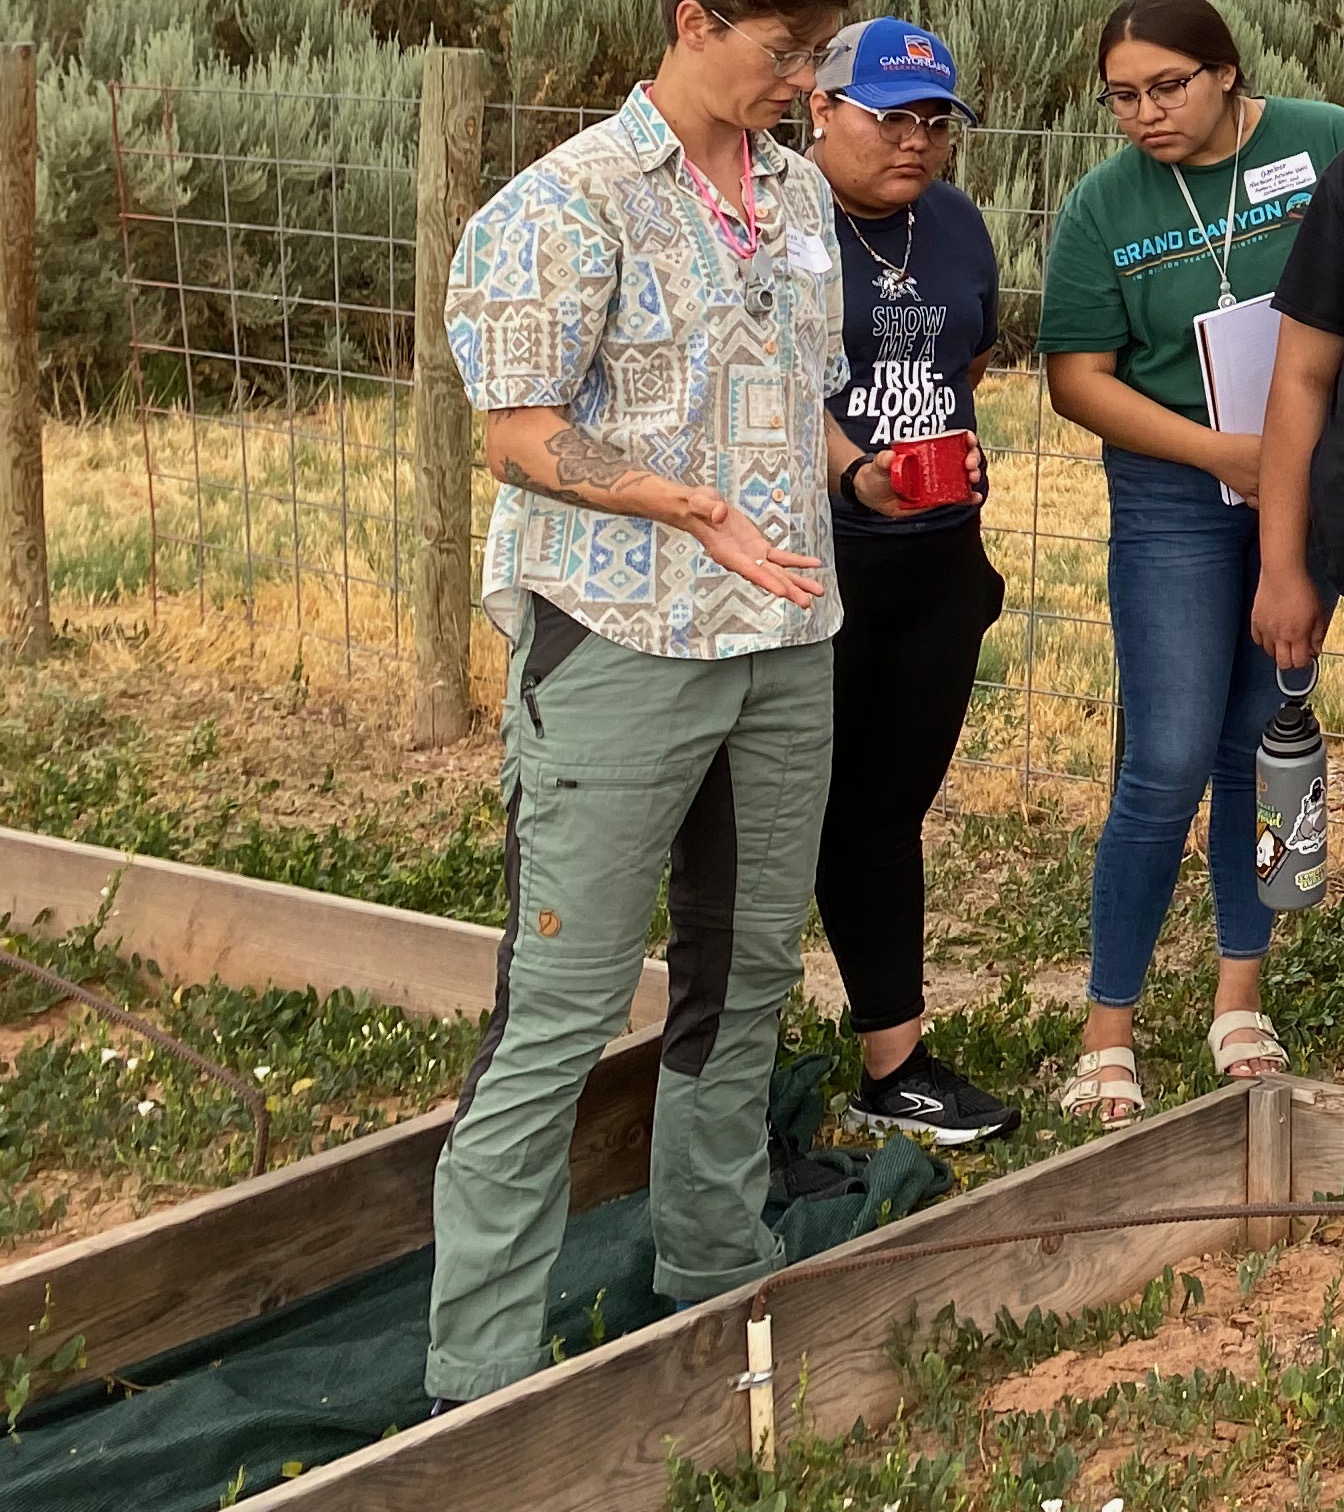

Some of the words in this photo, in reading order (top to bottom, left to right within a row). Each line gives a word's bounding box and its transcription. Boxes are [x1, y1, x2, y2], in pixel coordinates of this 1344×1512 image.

[1113, 230, 1184, 267] GRAND
[1187, 200, 1283, 246] CANYON
[872, 306, 947, 337] SHOW
[877, 333, 916, 363] ME
[917, 332, 936, 363] A
[873, 361, 943, 389] TRUE-
[847, 387, 956, 417] BLOODED
[870, 415, 948, 445] AGGIE
